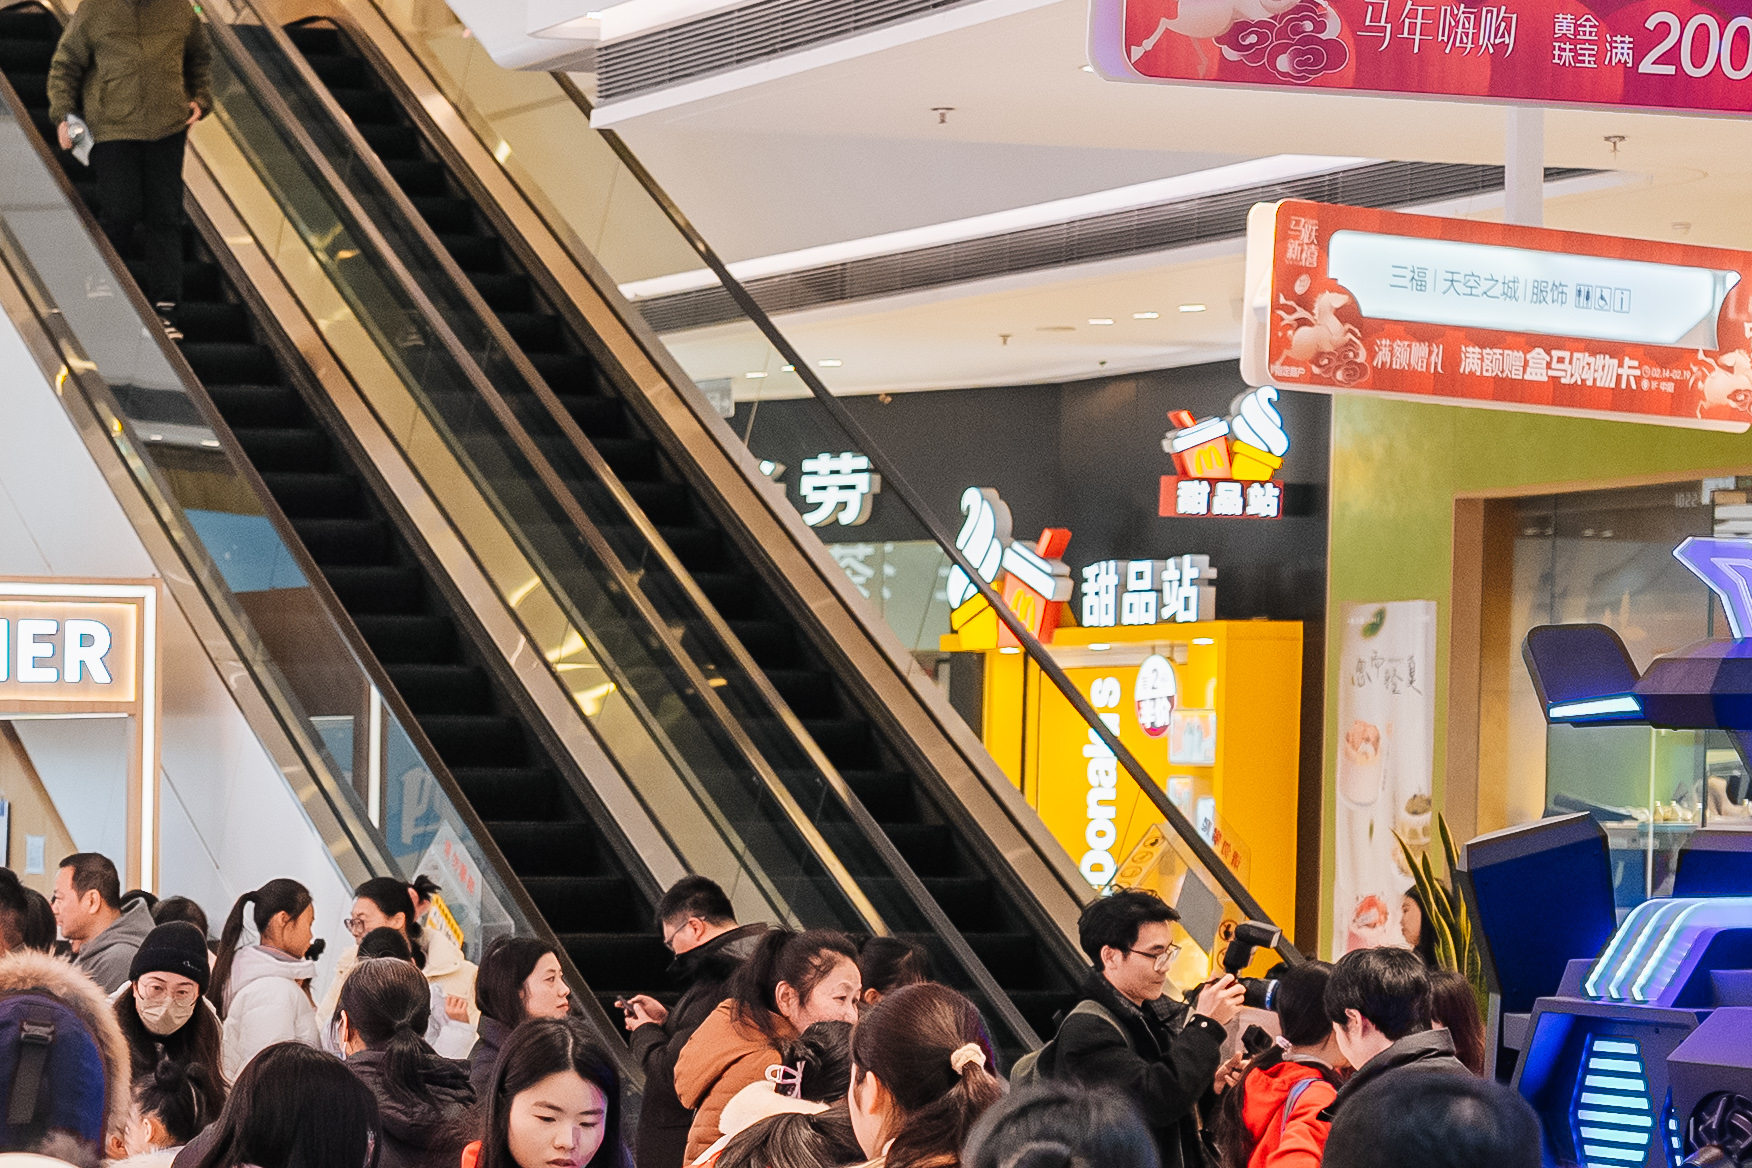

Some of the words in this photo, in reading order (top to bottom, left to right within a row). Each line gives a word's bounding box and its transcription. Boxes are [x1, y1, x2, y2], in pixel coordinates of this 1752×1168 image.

[1357, 0, 1518, 58] 马年嗨购
[1553, 13, 1600, 41] 黄金
[1552, 42, 1598, 69] 珠宝
[1389, 264, 1428, 294] 三福
[1442, 269, 1519, 302] 天空之城
[1530, 280, 1569, 308] 服饰
[1372, 338, 1444, 374] 满额赠礼
[1459, 345, 1641, 390] 满额赠盒马购物卡
[759, 452, 871, 526] 劳
[1081, 554, 1200, 627] 甜品站
